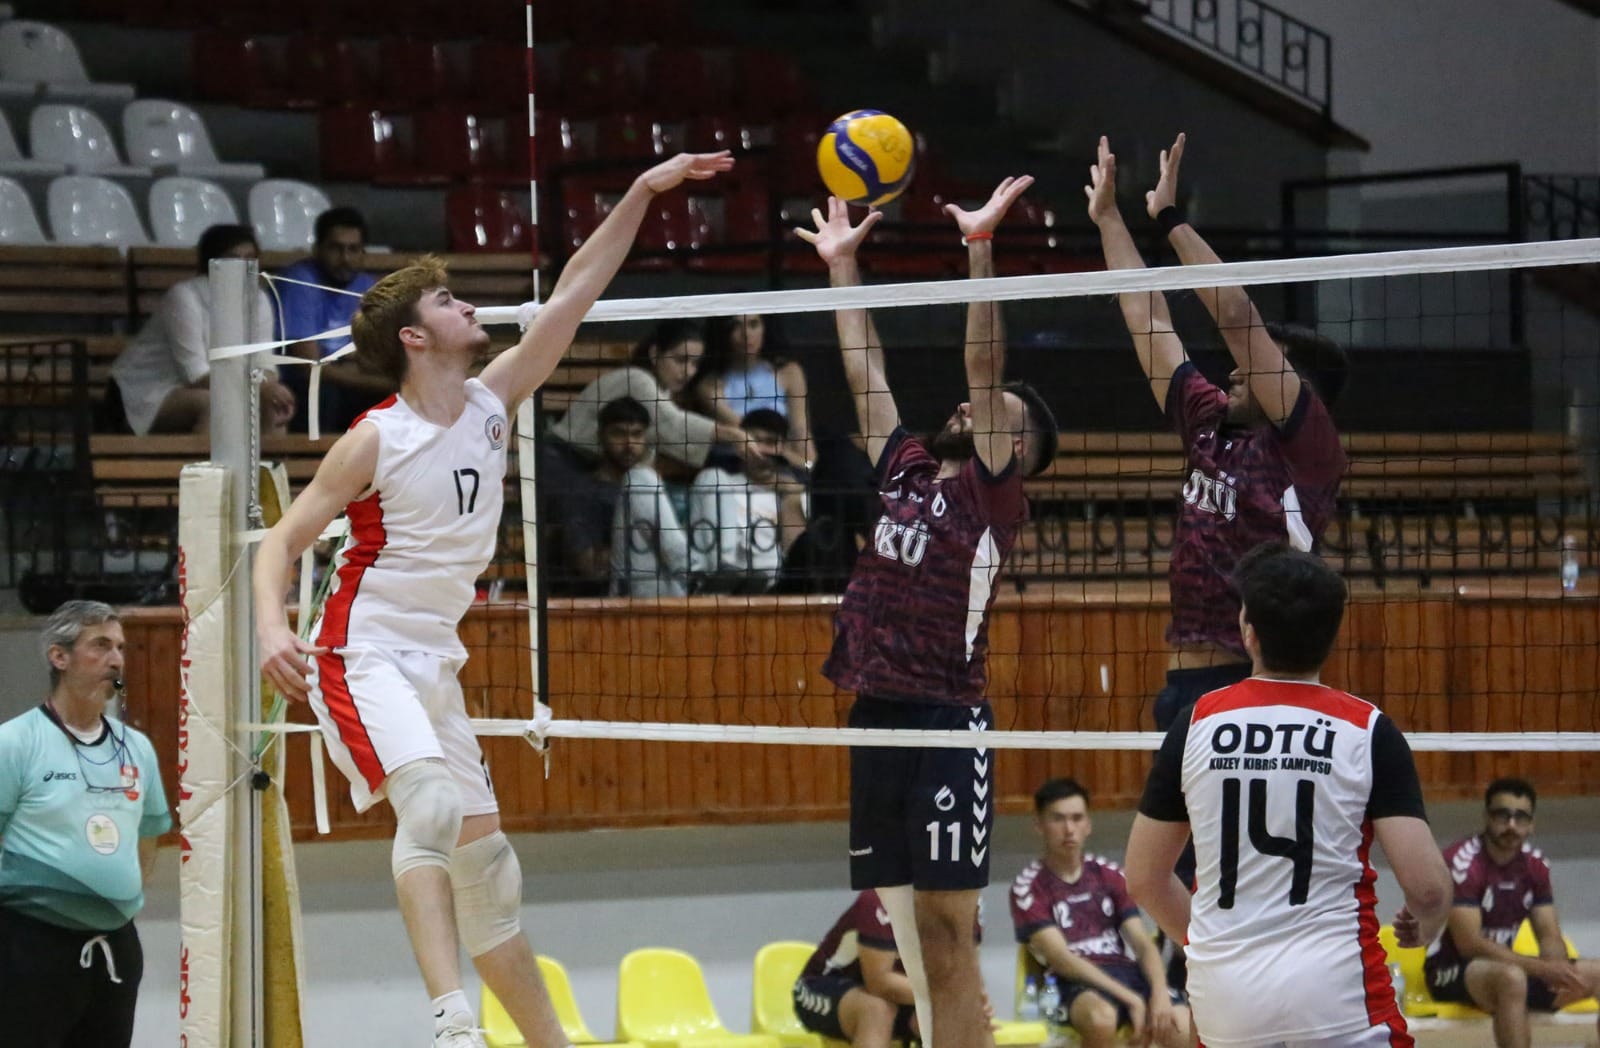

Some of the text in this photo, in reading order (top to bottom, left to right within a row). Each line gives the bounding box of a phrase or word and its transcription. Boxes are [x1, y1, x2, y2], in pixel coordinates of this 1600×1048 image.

[453, 468, 480, 516] 17
[874, 515, 932, 567] KÜ
[1211, 718, 1337, 759] ODTÜ
[54, 772, 77, 780] asics
[1209, 757, 1240, 771] KUZEY
[1243, 757, 1278, 771] KIBRIS
[926, 821, 961, 862] 11
[1217, 778, 1315, 909] 14
